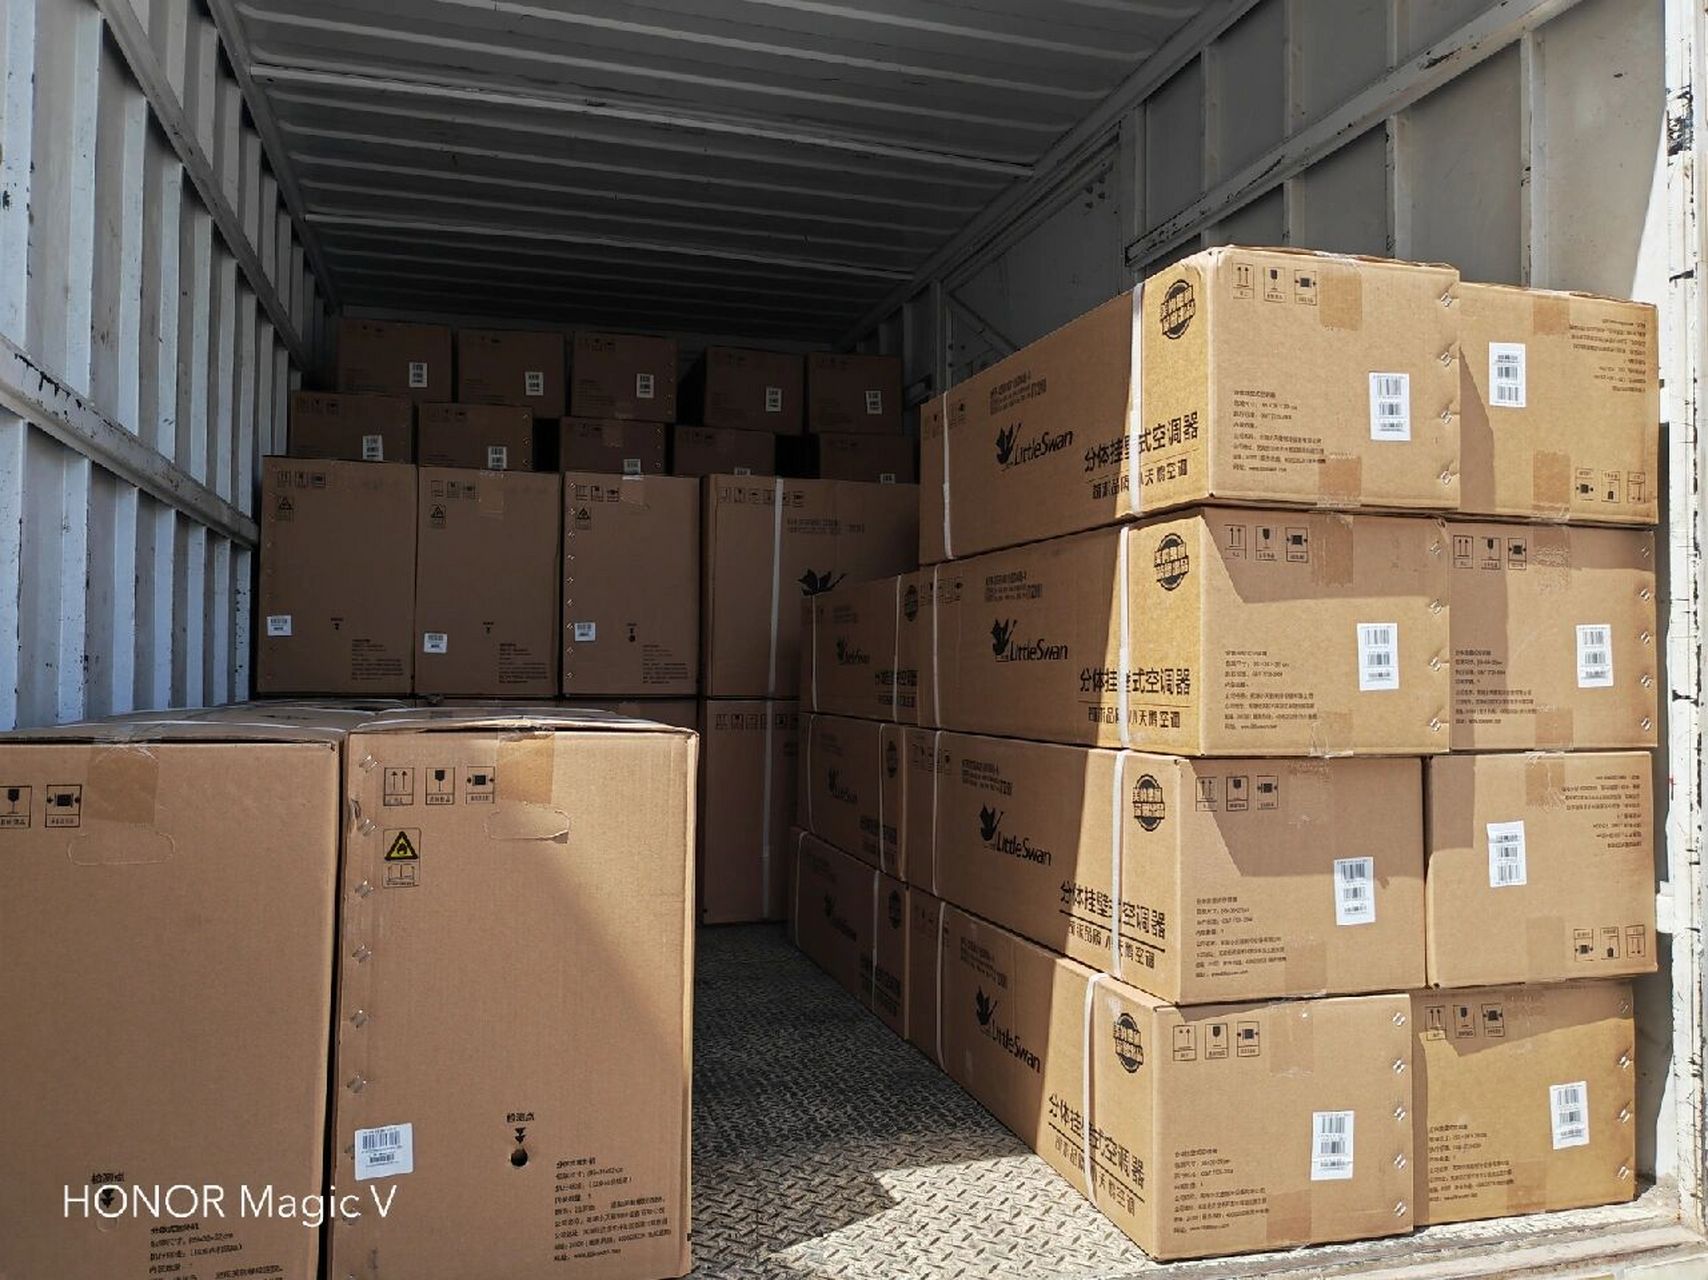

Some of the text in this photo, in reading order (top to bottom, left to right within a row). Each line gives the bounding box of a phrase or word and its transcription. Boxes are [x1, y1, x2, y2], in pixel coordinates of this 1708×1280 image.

[1080, 667, 1191, 696] 分体挂式空调器
